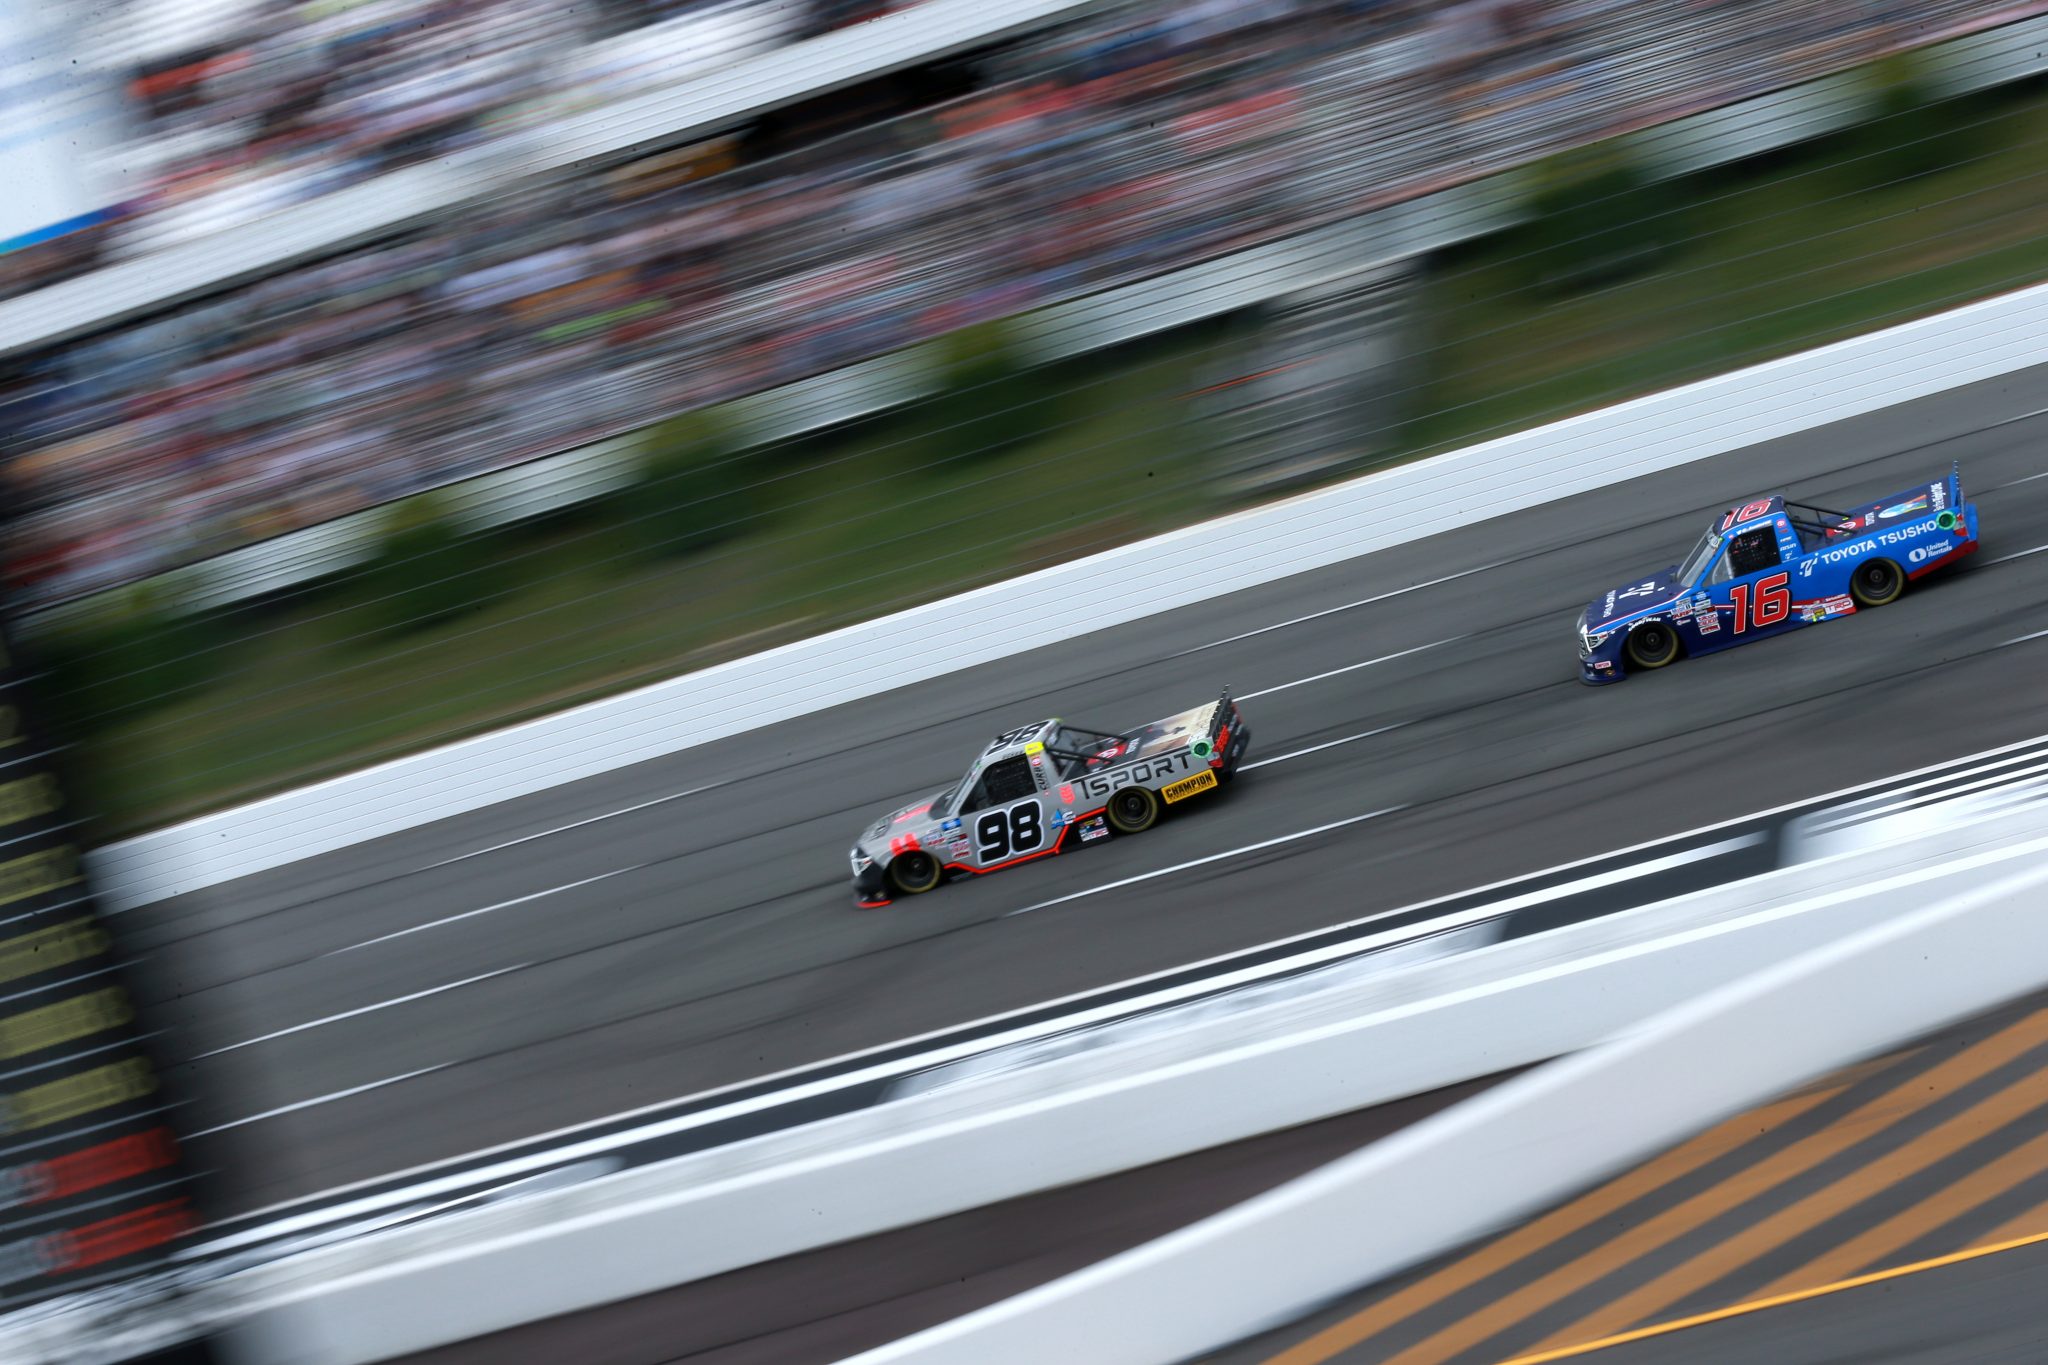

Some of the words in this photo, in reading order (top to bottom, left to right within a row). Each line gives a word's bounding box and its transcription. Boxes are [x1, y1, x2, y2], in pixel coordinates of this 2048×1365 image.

[1821, 540, 1877, 564] TOYOTA
[1878, 520, 1938, 546] TSUSHO
[1926, 539, 1949, 552] United
[1927, 545, 1953, 558] Rentals
[1730, 571, 1790, 635] 16
[1166, 773, 1213, 799] CHAMPION
[976, 799, 1043, 865] 98
